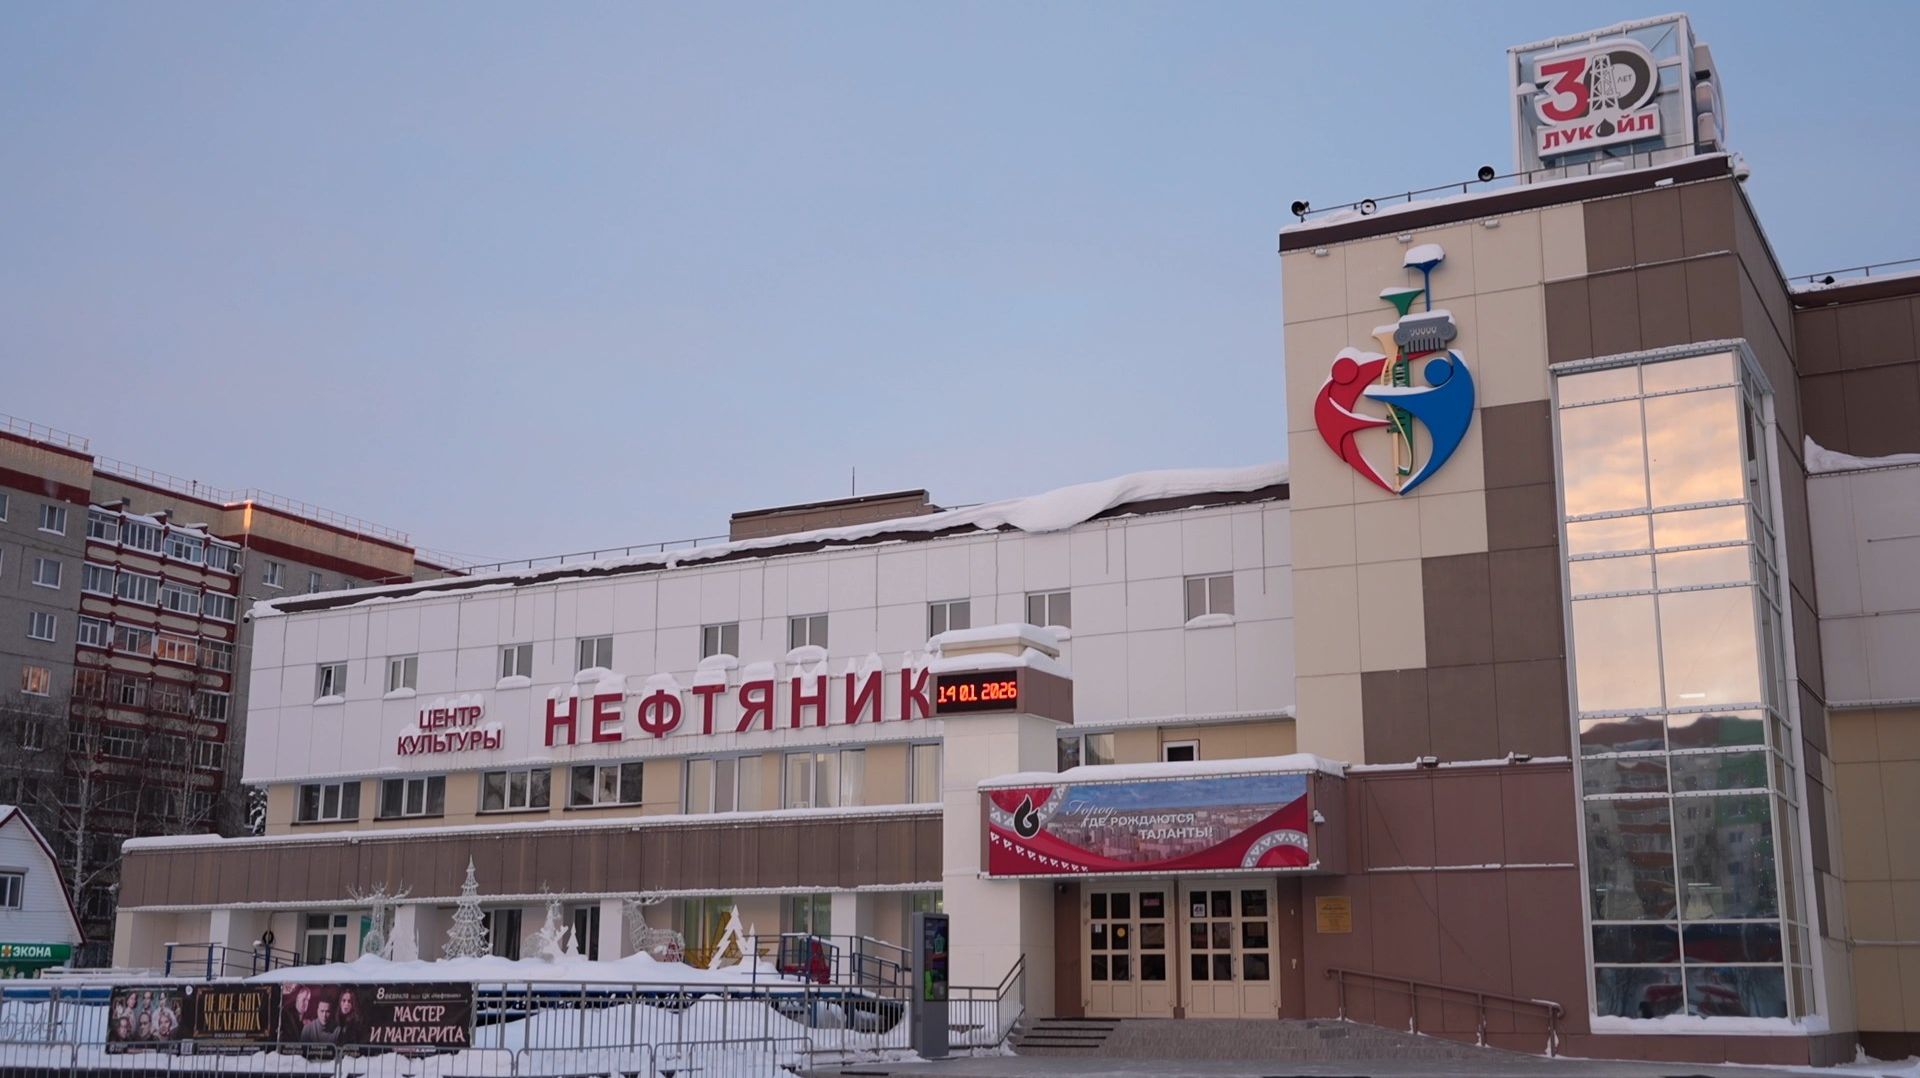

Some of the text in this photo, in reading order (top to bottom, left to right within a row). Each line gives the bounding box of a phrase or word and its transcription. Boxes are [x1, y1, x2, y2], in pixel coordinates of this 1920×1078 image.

[1617, 73, 1632, 84] ЛЕТ
[938, 681, 1017, 703] 14 01 2026
[544, 665, 931, 747] НЕФТЯНИК
[419, 705, 481, 731] ЦЕНТР
[397, 728, 502, 756] КУЛЬТУРЫ
[1080, 813, 1195, 829] ГДЕ РОЖДАЮТСЯ
[1138, 826, 1213, 840] ТАЛАНТЫ!
[13, 946, 51, 957] ЭКОНА
[376, 987, 385, 1000] 8
[393, 1005, 446, 1023] МАСТЕР
[369, 1025, 466, 1043] И МАРГАРИТА
